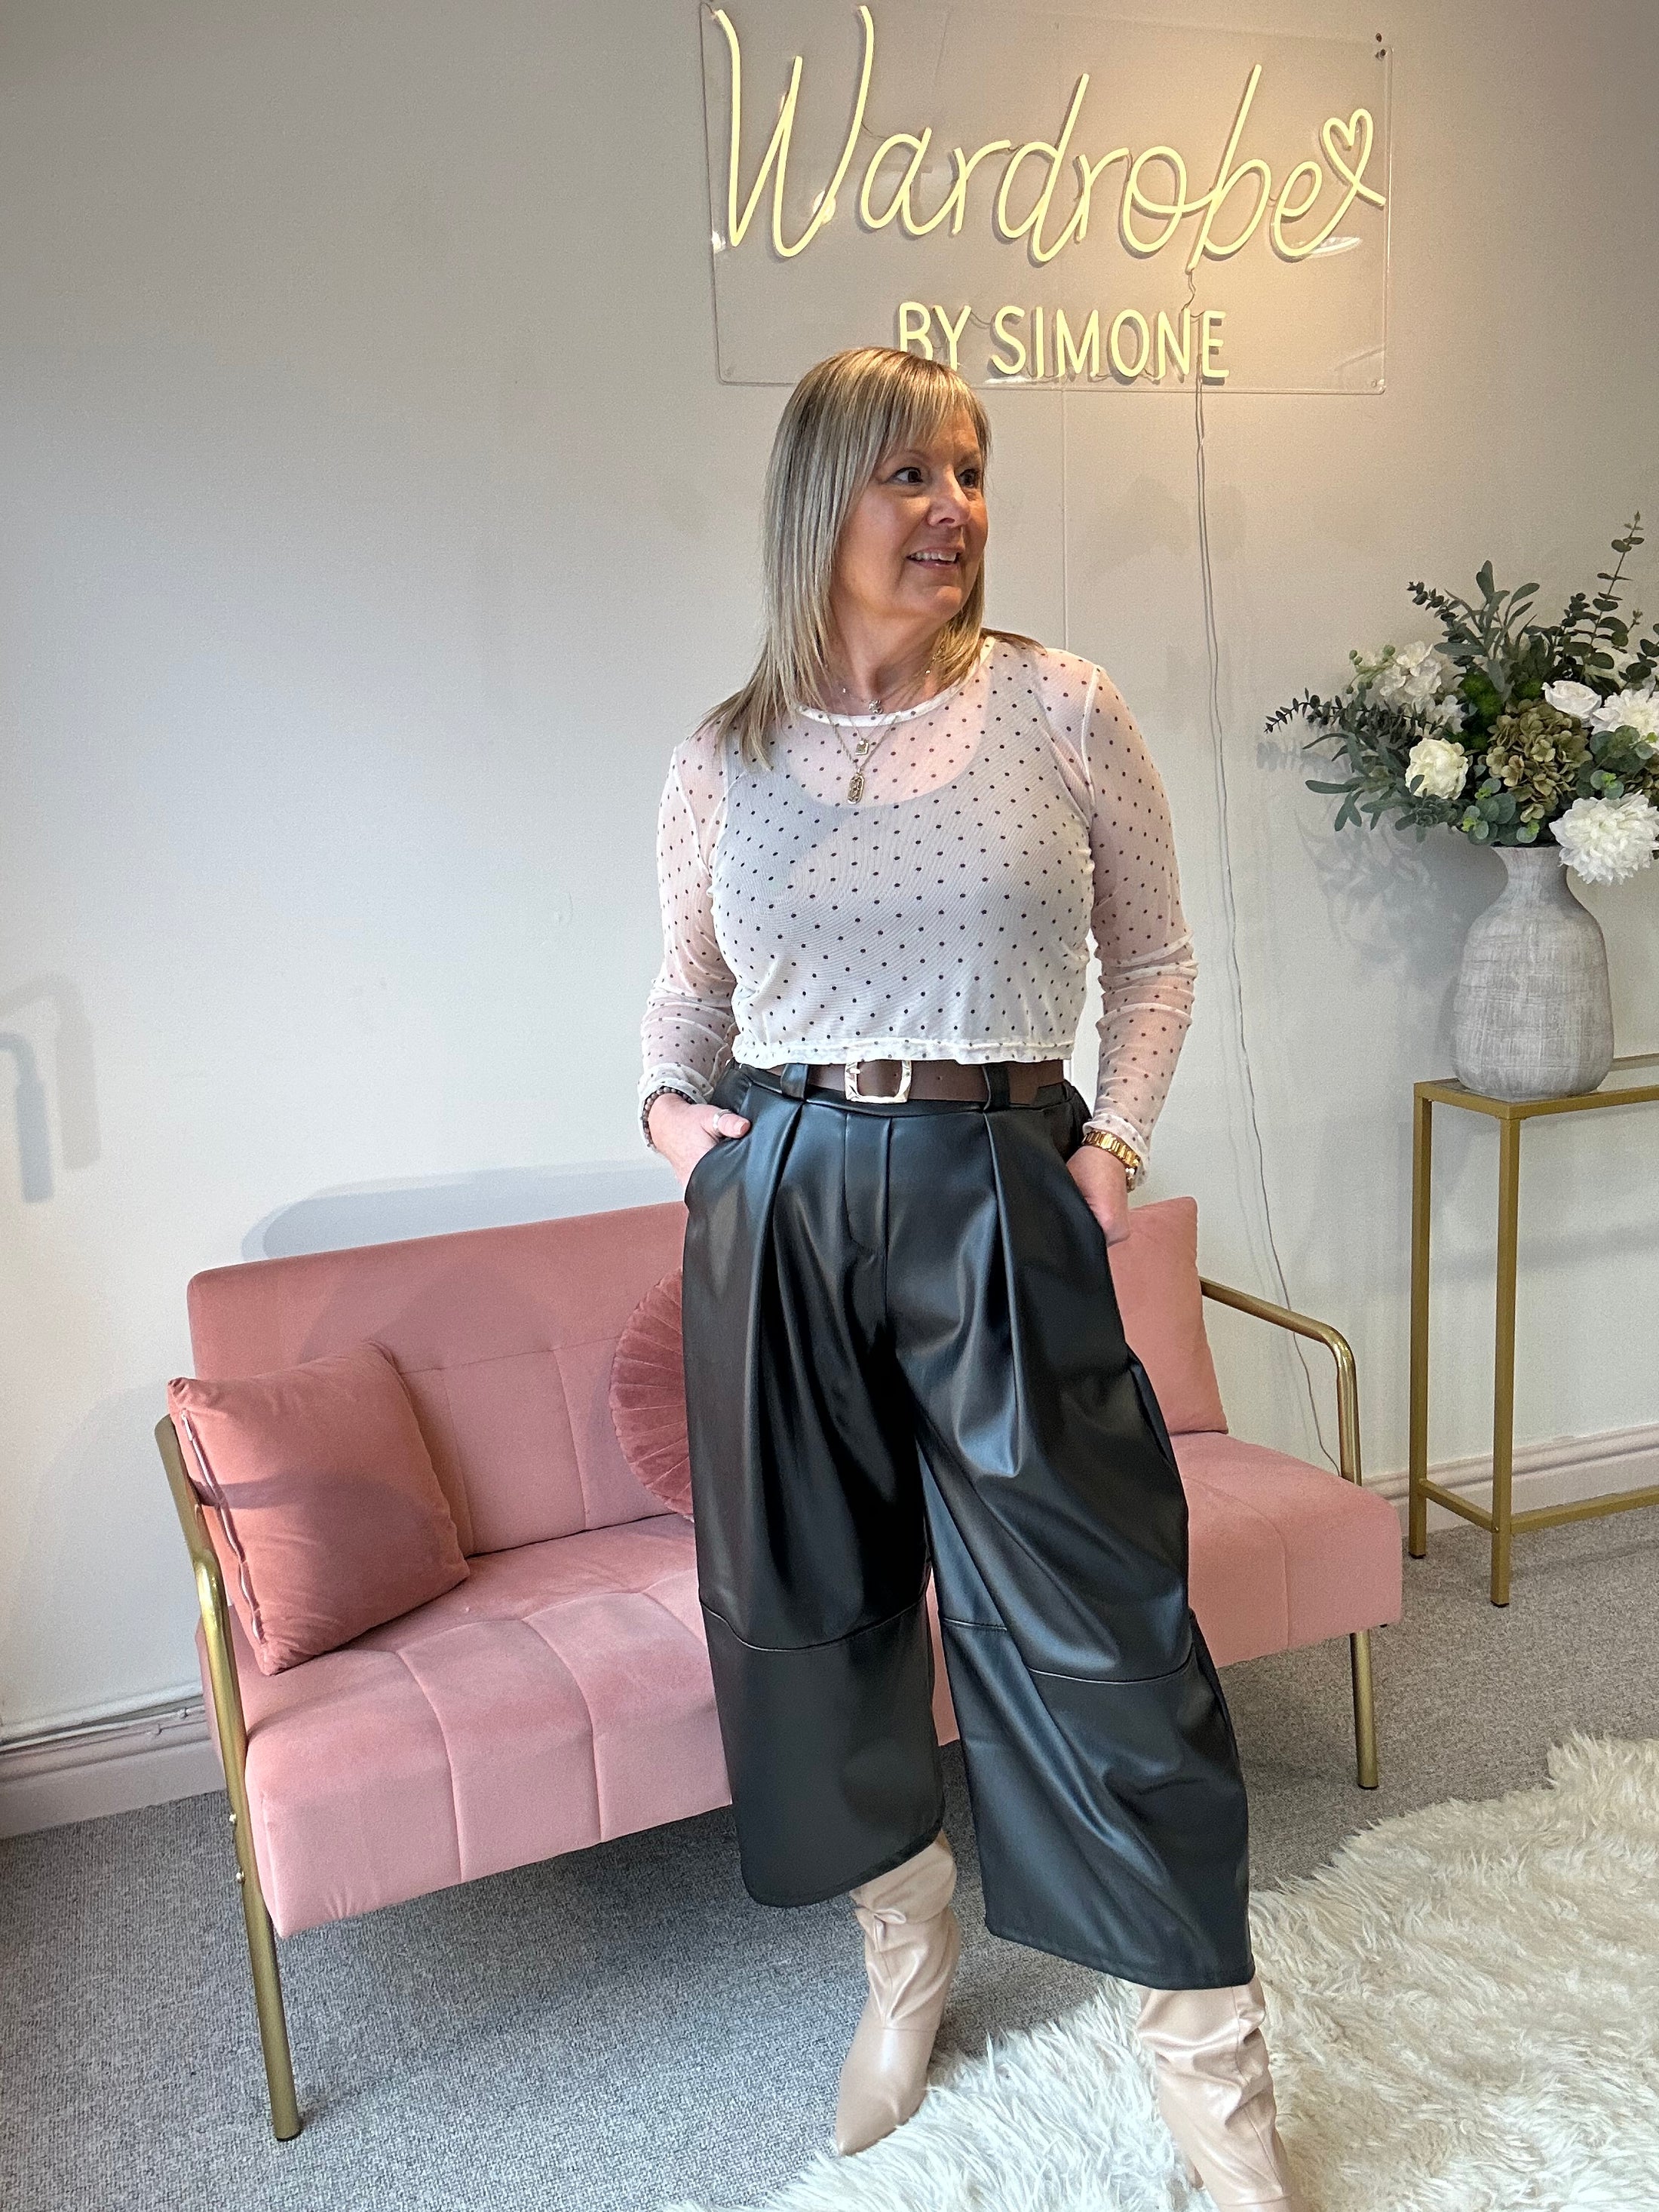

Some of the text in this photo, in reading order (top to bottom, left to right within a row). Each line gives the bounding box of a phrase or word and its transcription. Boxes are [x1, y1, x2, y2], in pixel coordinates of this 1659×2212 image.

[714, 5, 1386, 272] Wardrobe
[898, 301, 1230, 379] BY SIMONE
